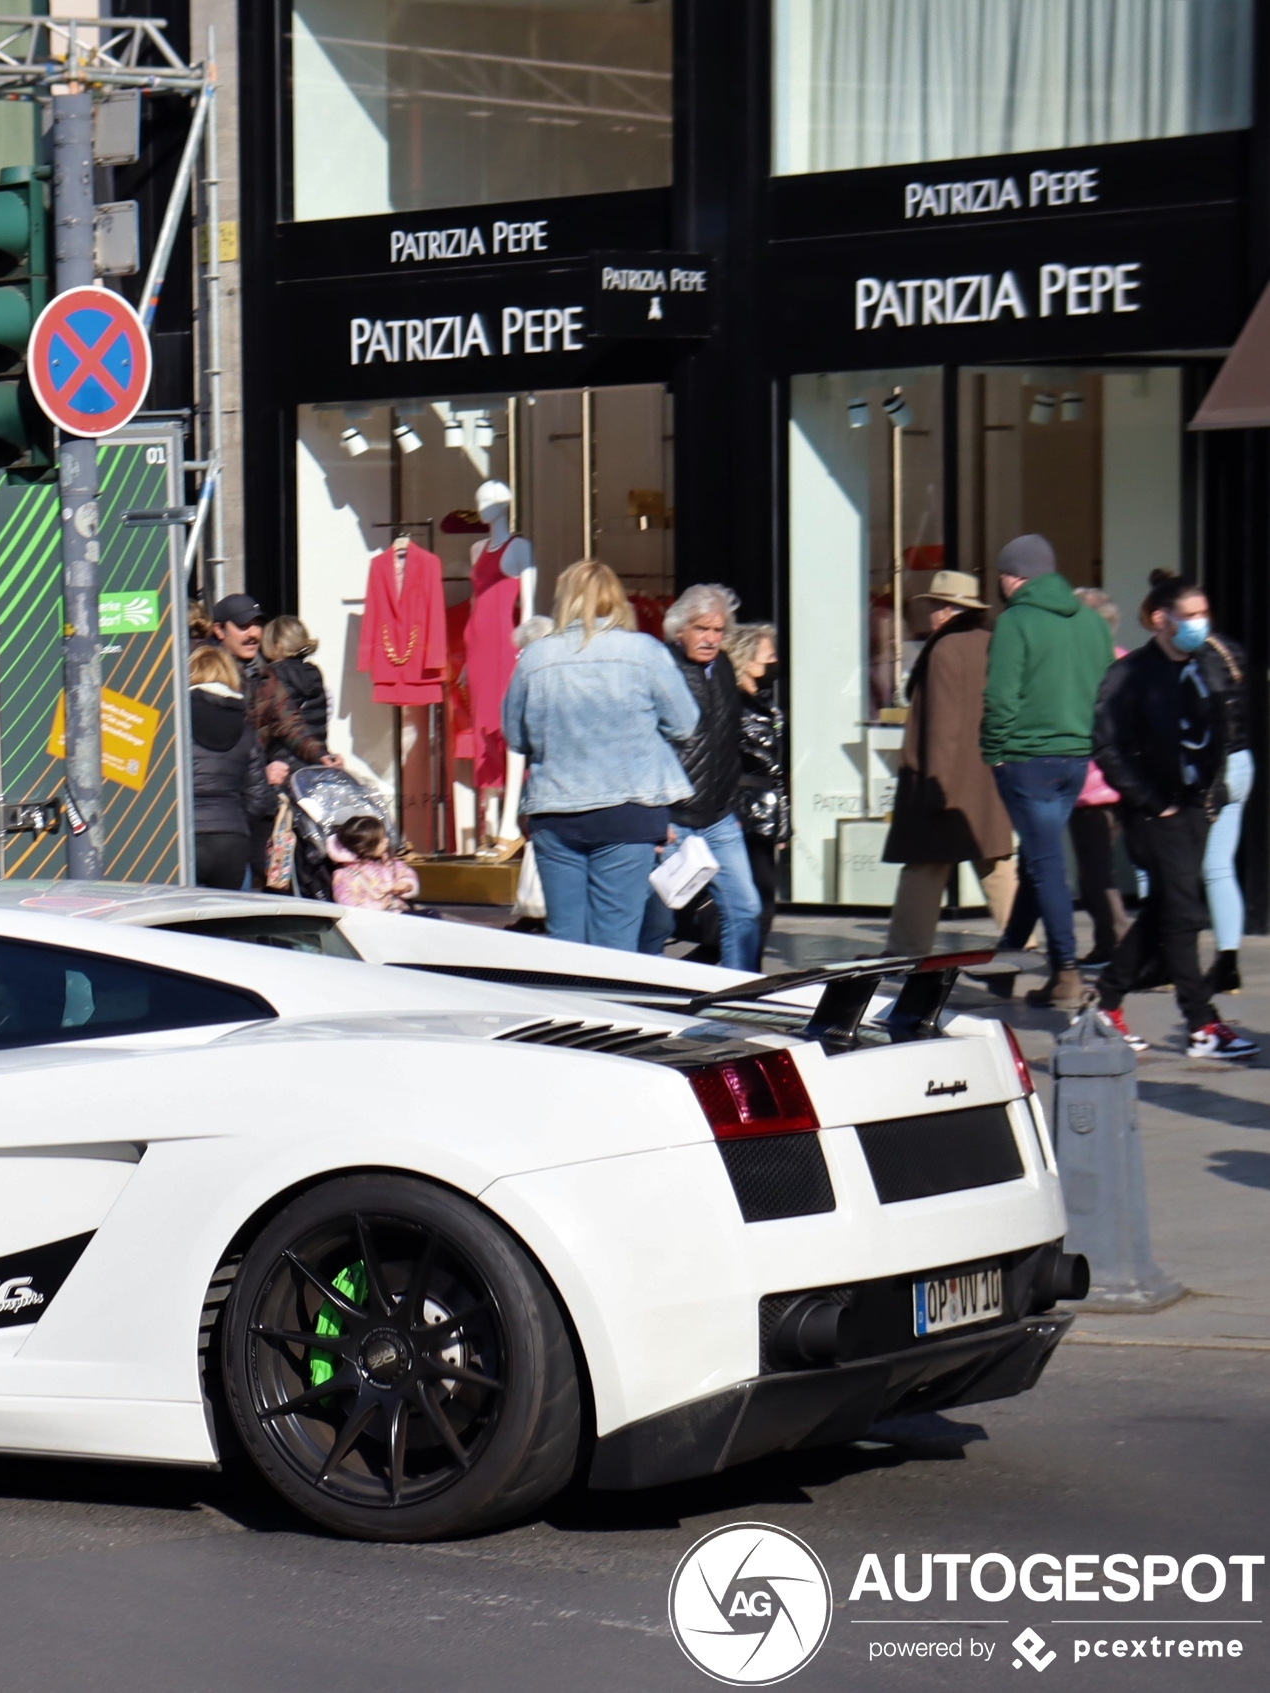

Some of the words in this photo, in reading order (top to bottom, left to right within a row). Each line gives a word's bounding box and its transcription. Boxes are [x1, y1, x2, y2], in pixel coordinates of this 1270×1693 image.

[905, 176, 1021, 219] PATRIZIA
[1029, 168, 1100, 207] PEPE
[390, 226, 486, 263] PATRIZIA
[493, 221, 548, 254] PEPE
[602, 266, 667, 291] PATRIZIA
[670, 267, 707, 292] PEPE
[855, 270, 1027, 331] PATRIZIA
[1040, 263, 1141, 318] PEPE
[350, 312, 491, 365] PATRIZIA
[502, 306, 584, 355] PEPE
[146, 446, 167, 465] 01
[928, 1280, 948, 1323] OP
